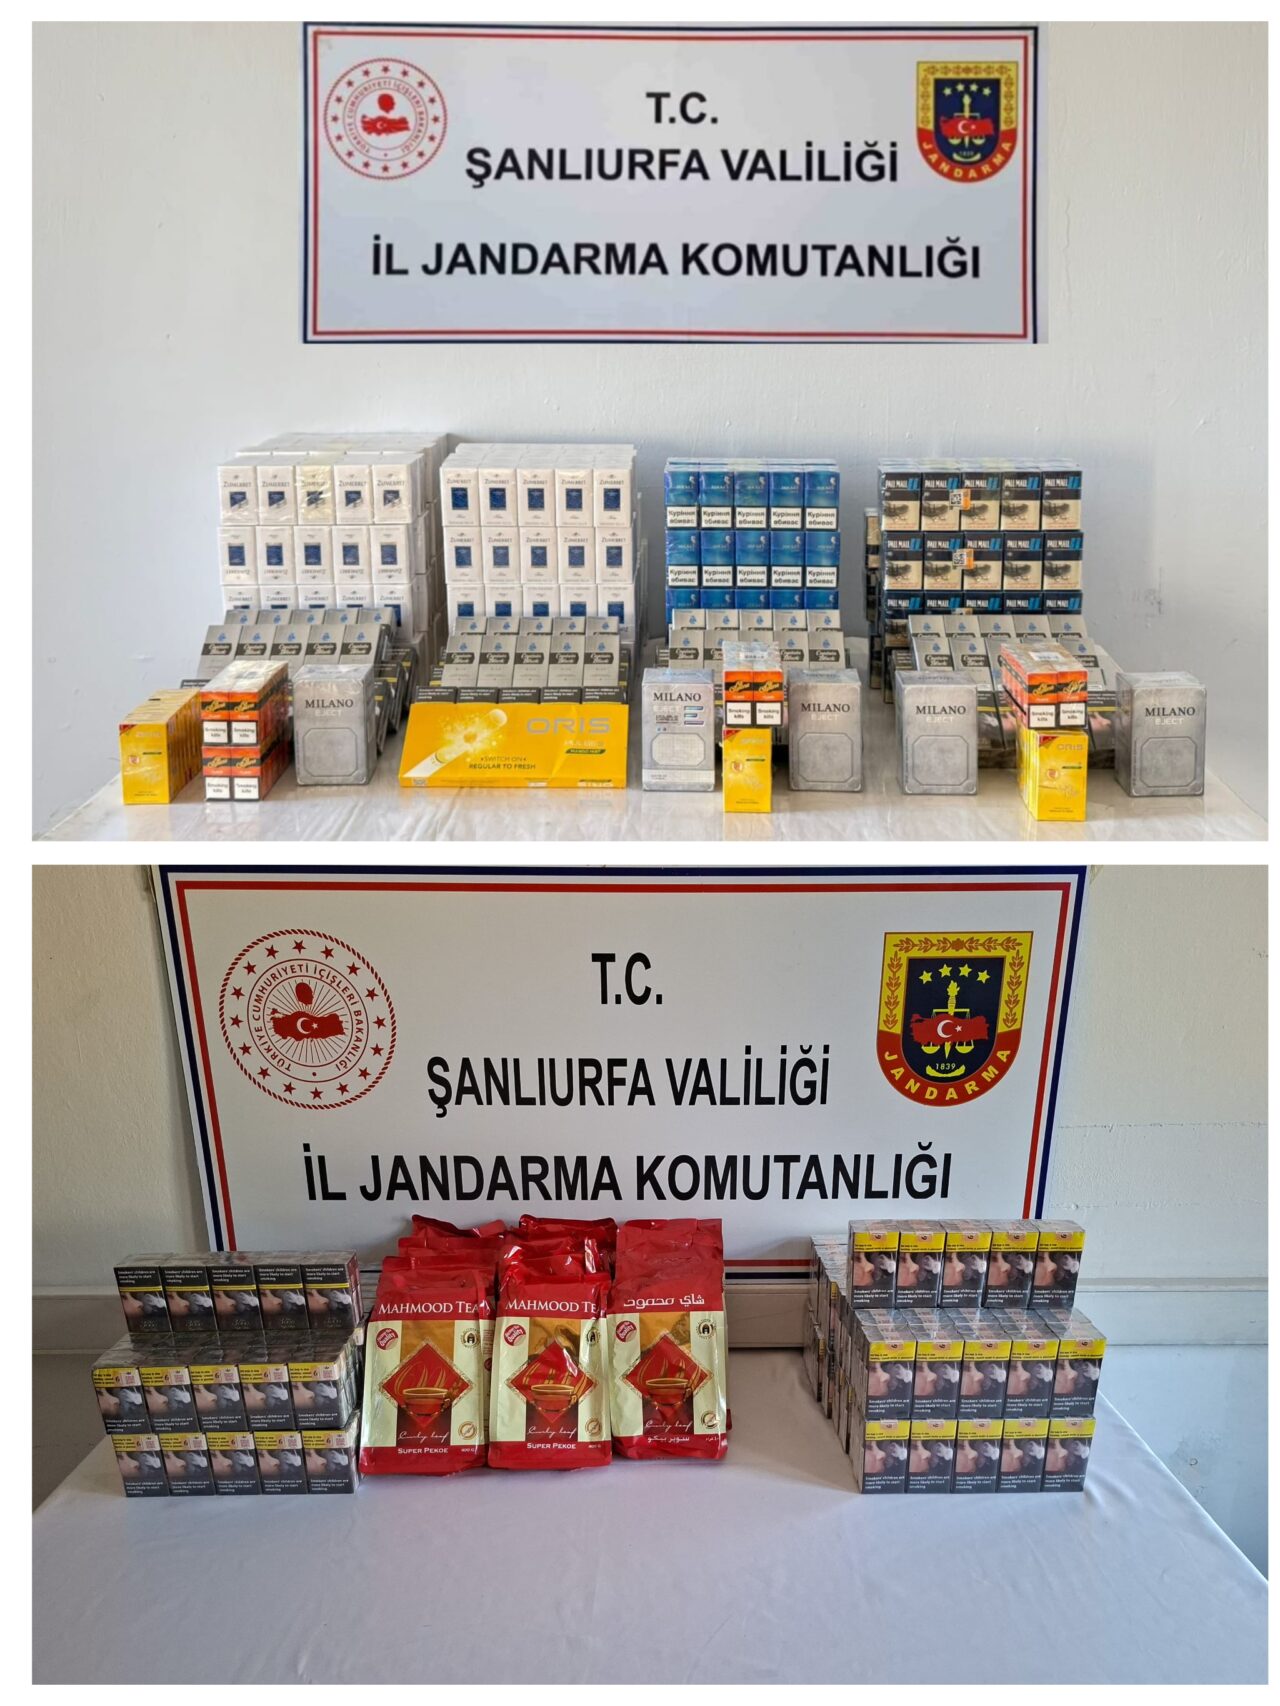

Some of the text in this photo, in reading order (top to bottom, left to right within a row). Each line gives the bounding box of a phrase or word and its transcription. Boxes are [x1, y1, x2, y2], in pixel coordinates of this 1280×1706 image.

[646, 92, 718, 124] T.C.
[466, 141, 897, 188] ŞANLIURFA VALİLİĞİ
[921, 140, 1013, 179] JANDARMA
[373, 235, 979, 278] İL JANDARMA KOMUTANLIĞI
[305, 699, 353, 708] MILANO
[653, 693, 702, 702] MILANO
[801, 703, 850, 712] MILANO
[915, 705, 967, 715] MILANO
[1145, 707, 1196, 716] MILANO
[527, 717, 611, 735] ORIS
[592, 953, 662, 1005] T.C.
[252, 962, 363, 1073] TÜRKİYE CUMHURİYETİ İÇİŞLERİ BAKANLIĞI
[935, 1062, 956, 1070] 1839
[427, 1045, 829, 1118] ŞANLIURFA VALİLİĞİ
[884, 1050, 1011, 1101] JANDARMA
[303, 1142, 951, 1201] İL JANDARMA KOMUTANLIĞI
[379, 1302, 453, 1314] MAHMOOD
[506, 1299, 579, 1312] MAHMOOD
[624, 1293, 705, 1309] شاي محمود
